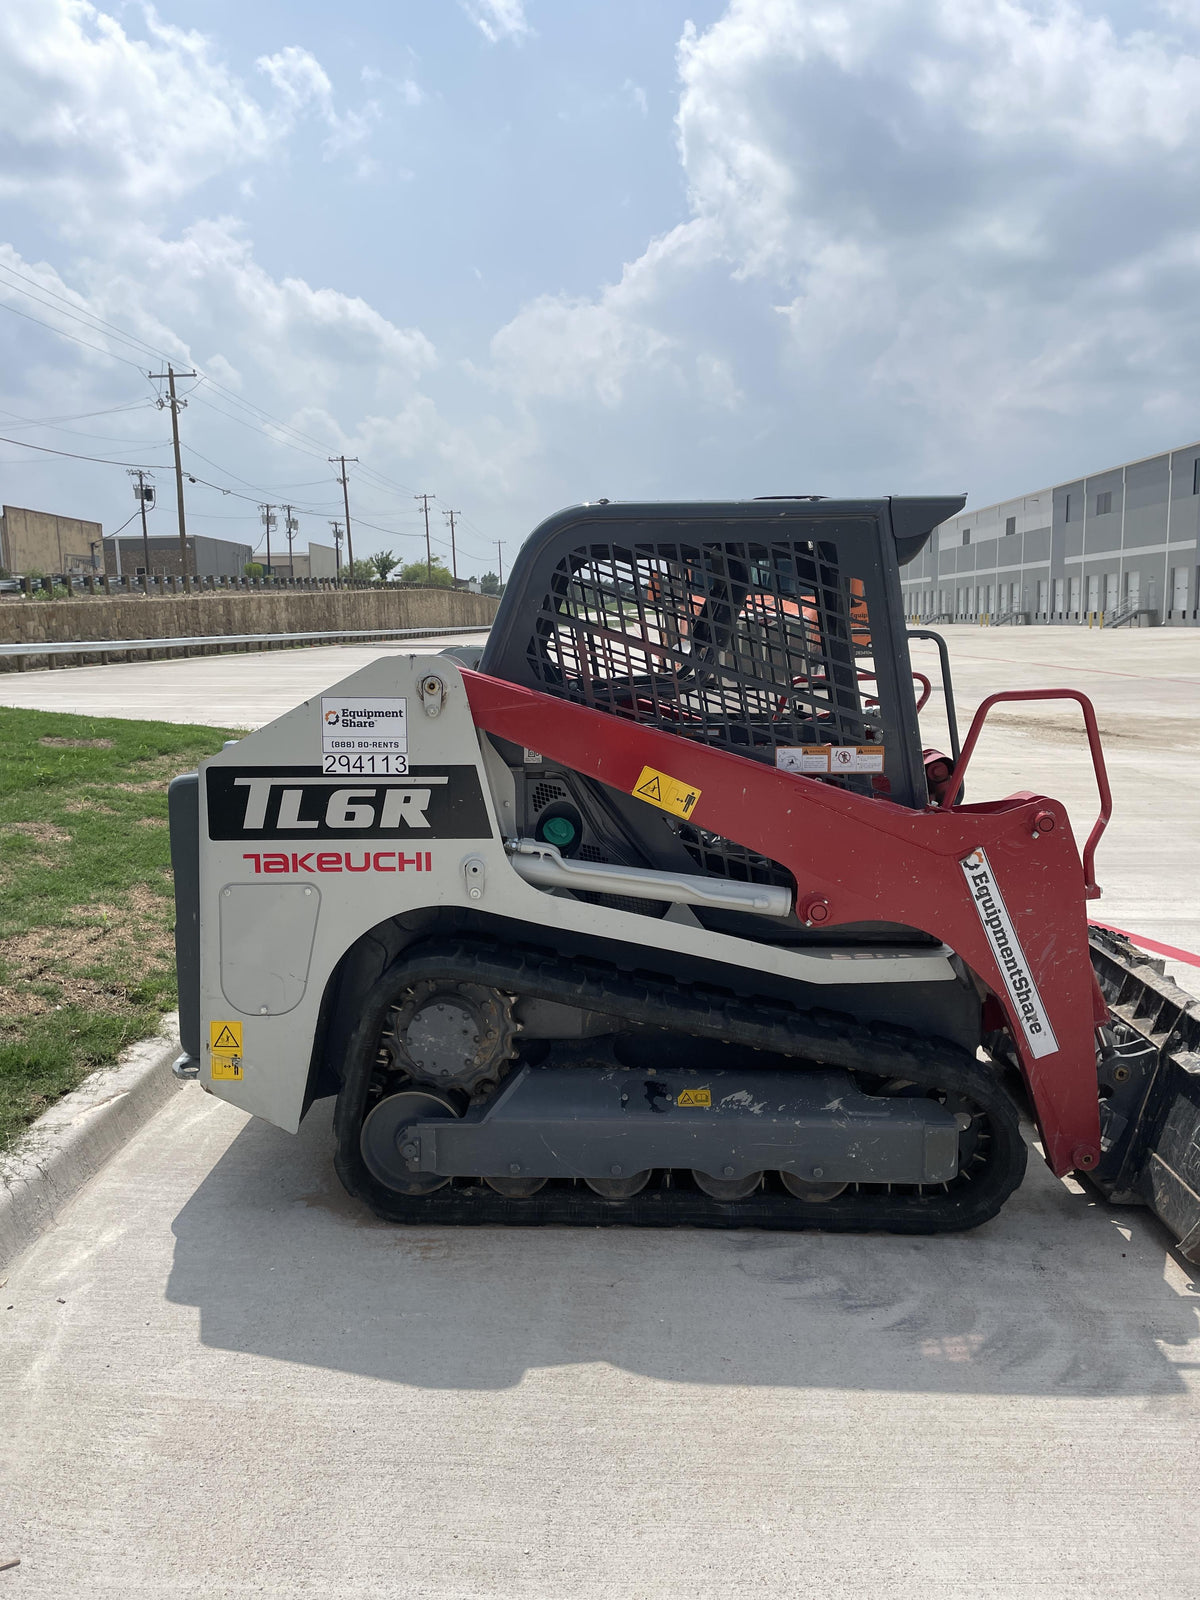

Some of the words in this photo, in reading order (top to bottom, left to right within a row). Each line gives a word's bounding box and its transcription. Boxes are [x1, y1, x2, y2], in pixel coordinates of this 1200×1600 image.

[342, 708, 403, 720] Equipment
[342, 719, 375, 728] Share
[331, 741, 355, 749] (888)
[357, 741, 399, 749] 80-RENTS
[325, 755, 407, 773] 294113
[233, 777, 449, 829] TL6R
[242, 851, 432, 873] TAKEUCHI
[971, 871, 1043, 1035] EquipmentShare
